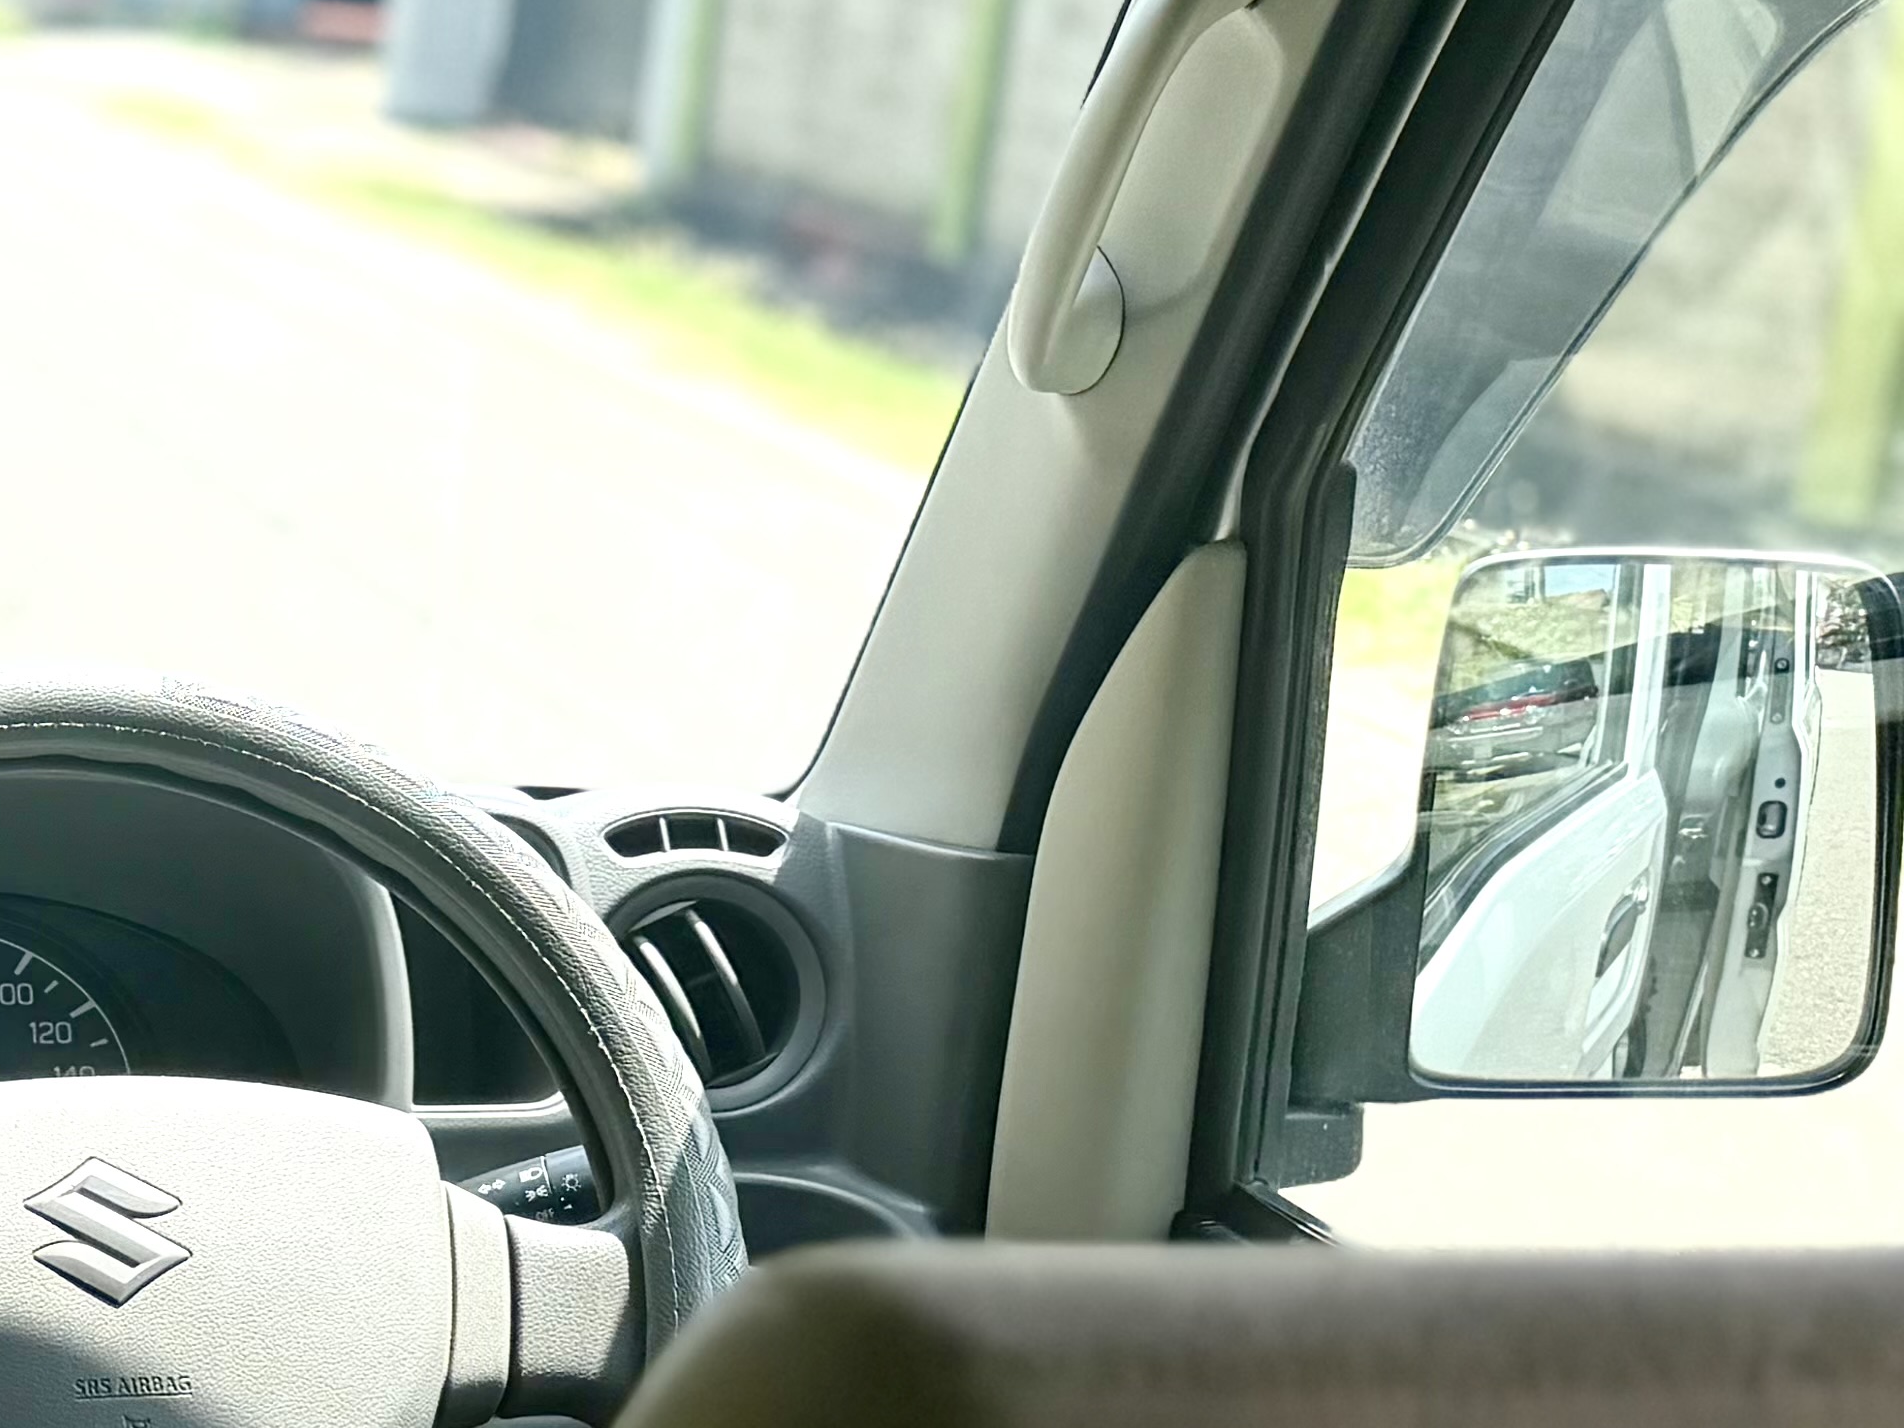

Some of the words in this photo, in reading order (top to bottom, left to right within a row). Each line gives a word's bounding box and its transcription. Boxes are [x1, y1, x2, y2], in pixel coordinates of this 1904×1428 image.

[29, 1021, 73, 1045] 120
[73, 1377, 112, 1396] SRS
[118, 1375, 193, 1394] AIRBAG
